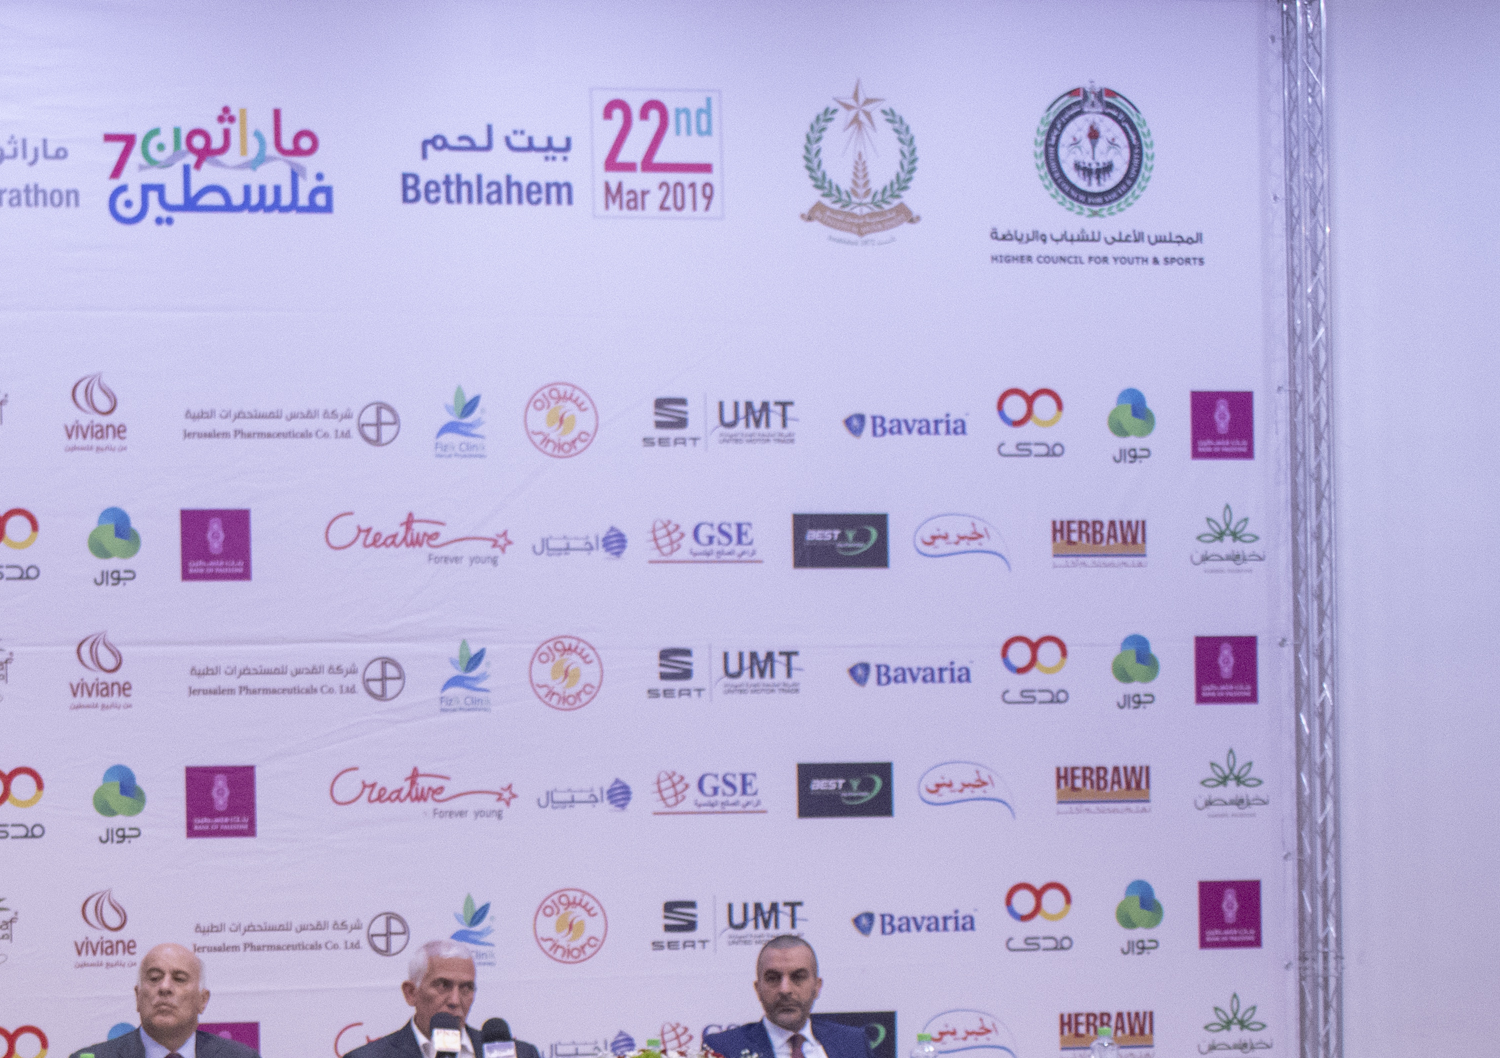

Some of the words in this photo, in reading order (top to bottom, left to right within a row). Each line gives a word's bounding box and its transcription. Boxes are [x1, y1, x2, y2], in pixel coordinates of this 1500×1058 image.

[140, 105, 320, 171] ماراثون
[420, 121, 497, 159] لحم
[503, 125, 574, 163] بيت
[602, 96, 714, 174] 22nd
[103, 134, 138, 181] 7
[108, 162, 335, 226] فلسطين
[401, 171, 575, 206] Bethlahem
[604, 181, 651, 212] Mar
[657, 181, 715, 212] 2019
[990, 226, 1048, 244] والرياضة
[1050, 228, 1102, 244] للشباب
[1147, 231, 1204, 247] المجلس
[990, 255, 1033, 265] HIGHER
[1036, 255, 1084, 266] COUNCIL
[1088, 255, 1109, 266] FOR
[1112, 255, 1149, 266] YOUTH
[1152, 256, 1160, 266] &
[1163, 255, 1206, 267] SPORTS
[718, 400, 796, 428] UMT
[65, 420, 127, 440] viviane
[871, 414, 966, 437] Bavaria
[643, 437, 699, 447] SEAT
[1113, 447, 1151, 464] جوال
[325, 512, 446, 549] Creative
[693, 522, 753, 547] GSE
[806, 529, 840, 542] BEST
[1052, 519, 1146, 546] HERBAWI
[428, 553, 464, 565] Forever
[469, 555, 498, 566] young
[94, 570, 137, 586] جوال
[723, 650, 801, 678] UMT
[876, 662, 971, 685] Bavaria
[70, 678, 132, 698] viviane
[648, 688, 704, 698] SEAT
[1117, 693, 1155, 710] جوال
[330, 767, 451, 804] Creative
[698, 773, 758, 798] GSE
[811, 778, 845, 791] BEST
[1056, 765, 1150, 792] HERBAWI
[433, 807, 469, 819] Forever
[474, 809, 503, 820] young
[99, 828, 142, 844] جوال
[727, 901, 805, 929] UMT
[880, 911, 975, 934] Bavaria
[295, 921, 330, 933] القدس
[332, 920, 362, 932] شركة
[74, 936, 136, 956] viviane
[193, 943, 240, 954] Jerusalem
[243, 941, 323, 952] Pharmaceuticals
[652, 940, 708, 950] SEAT
[1121, 939, 1159, 956] جوال
